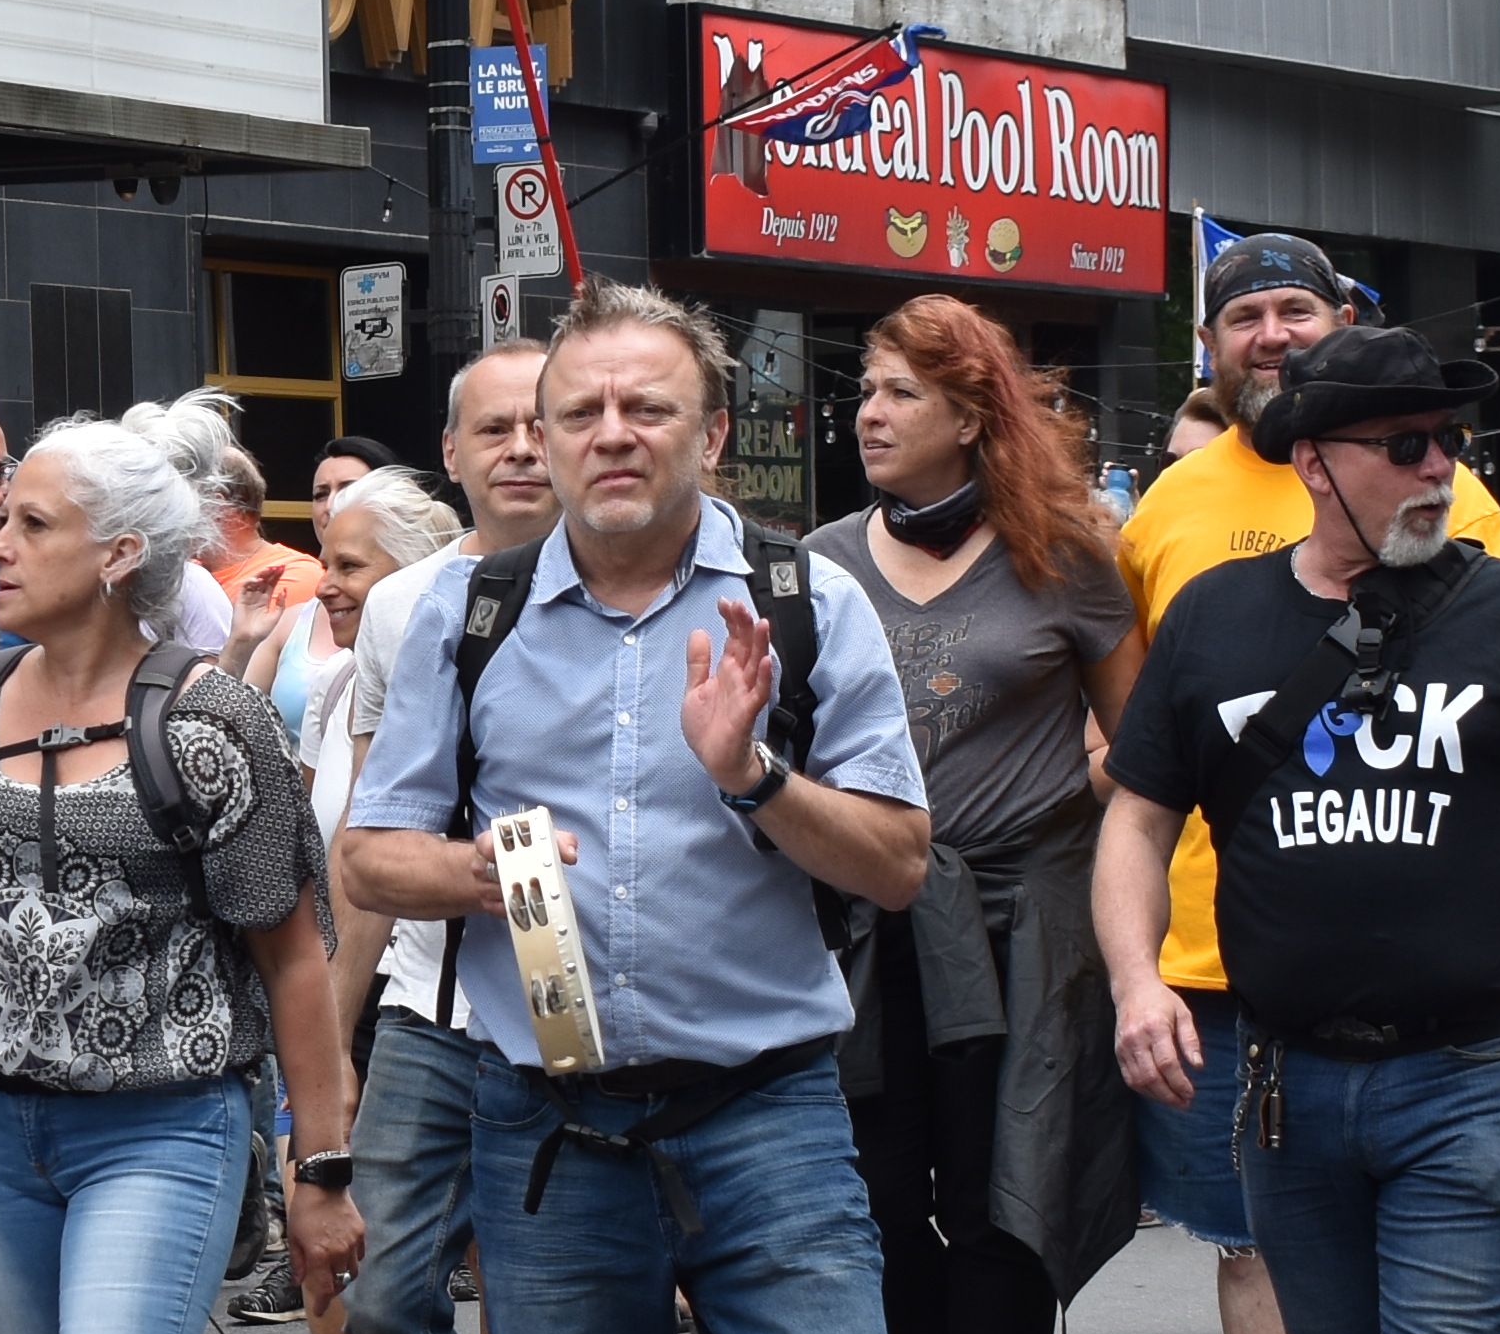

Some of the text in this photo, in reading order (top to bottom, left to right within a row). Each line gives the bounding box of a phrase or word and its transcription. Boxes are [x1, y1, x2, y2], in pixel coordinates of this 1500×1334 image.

[478, 61, 542, 78] LA NUT,
[477, 78, 544, 94] LE BRUT
[939, 70, 1038, 196] Pool
[1044, 85, 1161, 210] Room
[760, 206, 838, 247] Depuis 1912
[507, 236, 523, 246] LUN
[534, 233, 550, 244] VEN
[507, 249, 526, 259] AVRIL
[1070, 242, 1124, 273] Since 1912
[1270, 788, 1451, 849] LEGAULT
